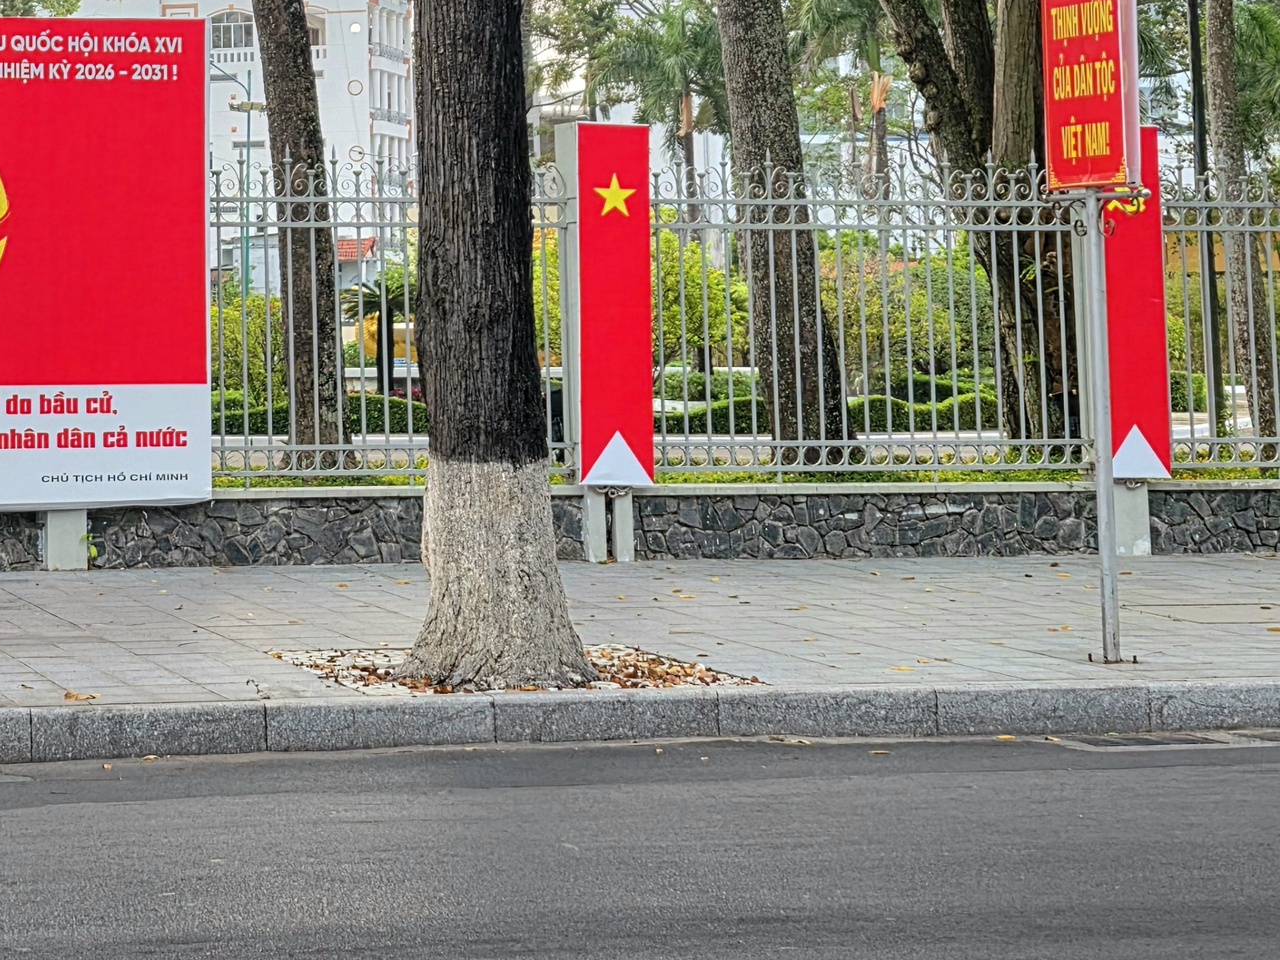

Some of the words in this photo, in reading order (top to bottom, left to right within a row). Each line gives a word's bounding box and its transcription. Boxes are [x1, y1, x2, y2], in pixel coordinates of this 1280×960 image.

[1051, 4, 1078, 46] THỊNH
[11, 30, 63, 52] QUỐC
[68, 32, 98, 57] HỘI
[103, 32, 151, 53] KHÓA
[155, 37, 182, 53] XVI
[49, 59, 71, 79] KỲ
[75, 64, 114, 80] 2026
[132, 64, 167, 80] 2031
[1054, 54, 1071, 100] CỦA
[1074, 55, 1093, 97] DÂN
[1095, 52, 1114, 100] TỘC
[1062, 116, 1082, 164] VIỆT
[1085, 122, 1109, 156] NAM!
[6, 395, 31, 414] do
[40, 392, 78, 414] bầu
[86, 391, 117, 414] cử,
[57, 428, 95, 448] dân
[103, 426, 128, 448] cả
[136, 427, 187, 447] nước
[42, 473, 68, 482] CHỦ
[73, 475, 102, 483] TỊCH
[130, 472, 151, 481] CHÍ
